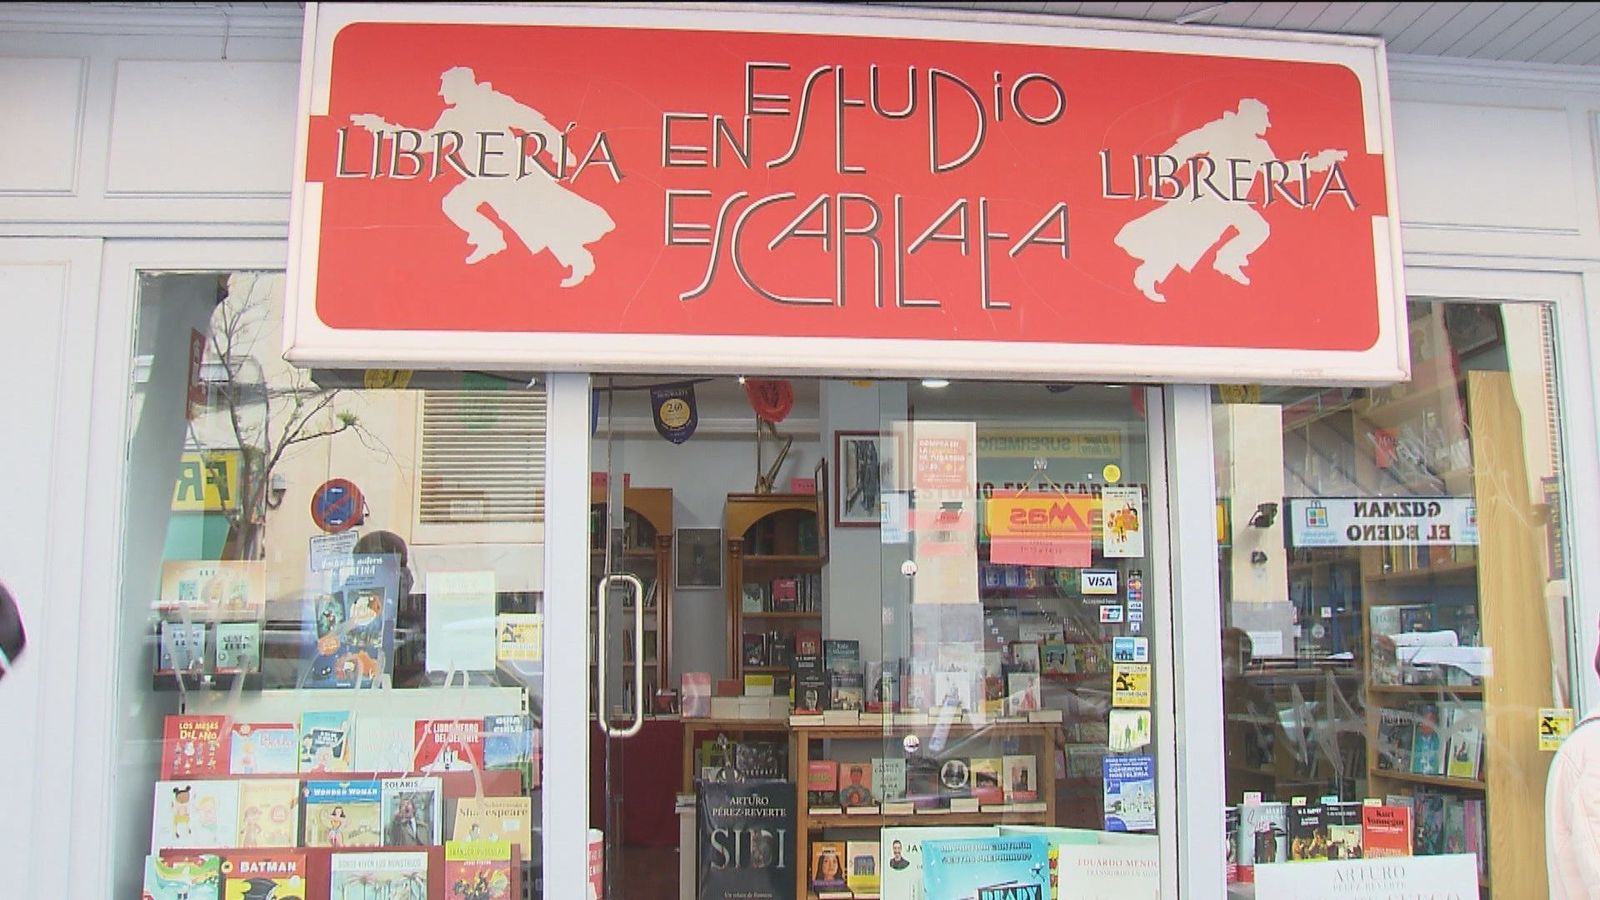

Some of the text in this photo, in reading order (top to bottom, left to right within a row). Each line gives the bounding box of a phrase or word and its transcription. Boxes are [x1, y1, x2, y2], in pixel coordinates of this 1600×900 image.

[661, 112, 753, 169] EN
[335, 121, 626, 184] LIBRERÍA
[1098, 148, 1360, 212] LIBRERÍA
[664, 189, 1071, 310] ESCARLATA
[1088, 576, 1113, 586] VISA
[384, 781, 418, 789] SOLARIS
[729, 796, 769, 806] ARTURO
[458, 807, 528, 818] Shaespeare
[240, 861, 297, 873] BATMAN
[1335, 865, 1406, 882] ARTURO
